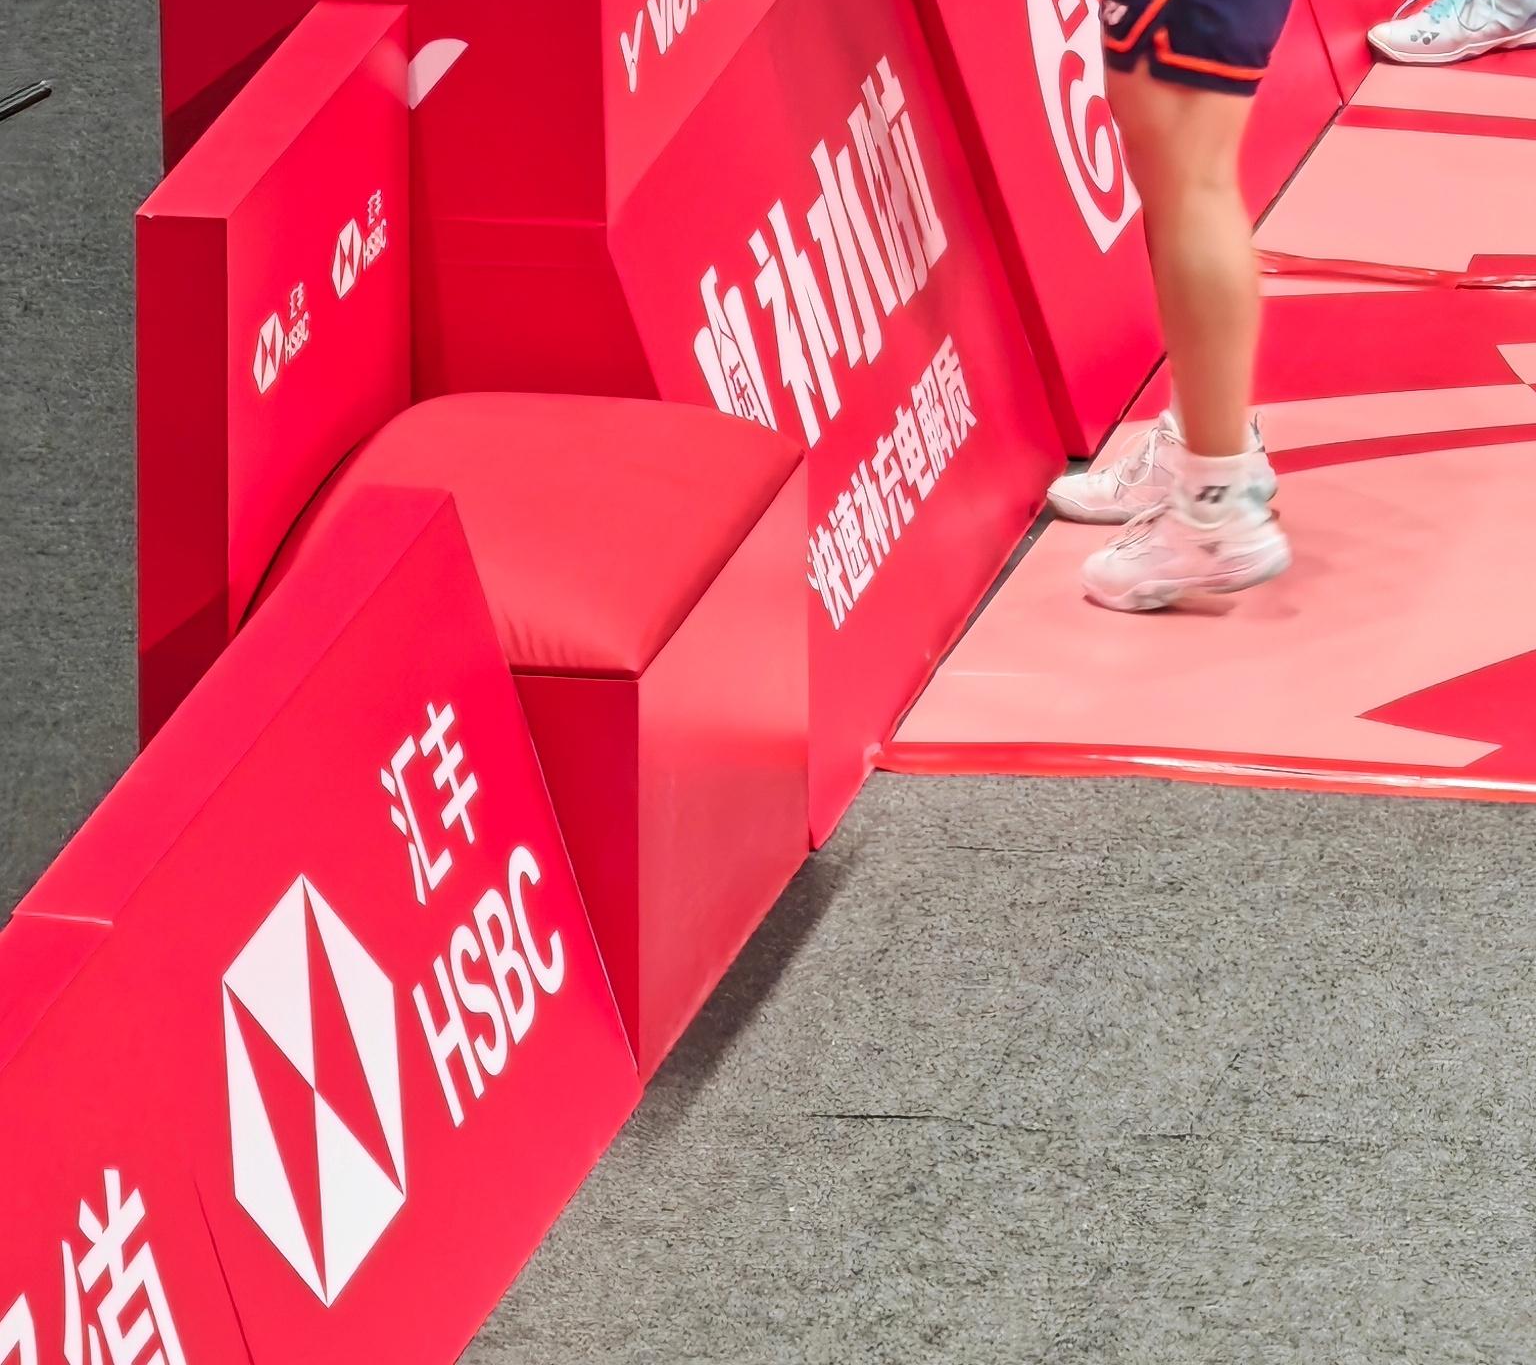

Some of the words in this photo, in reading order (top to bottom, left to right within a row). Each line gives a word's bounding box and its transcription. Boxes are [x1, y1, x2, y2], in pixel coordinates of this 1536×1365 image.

[284, 311, 310, 365] HSBC
[806, 333, 977, 631] 快速补充电解质
[379, 702, 478, 906] 汇丰
[411, 845, 565, 1128] HSBC
